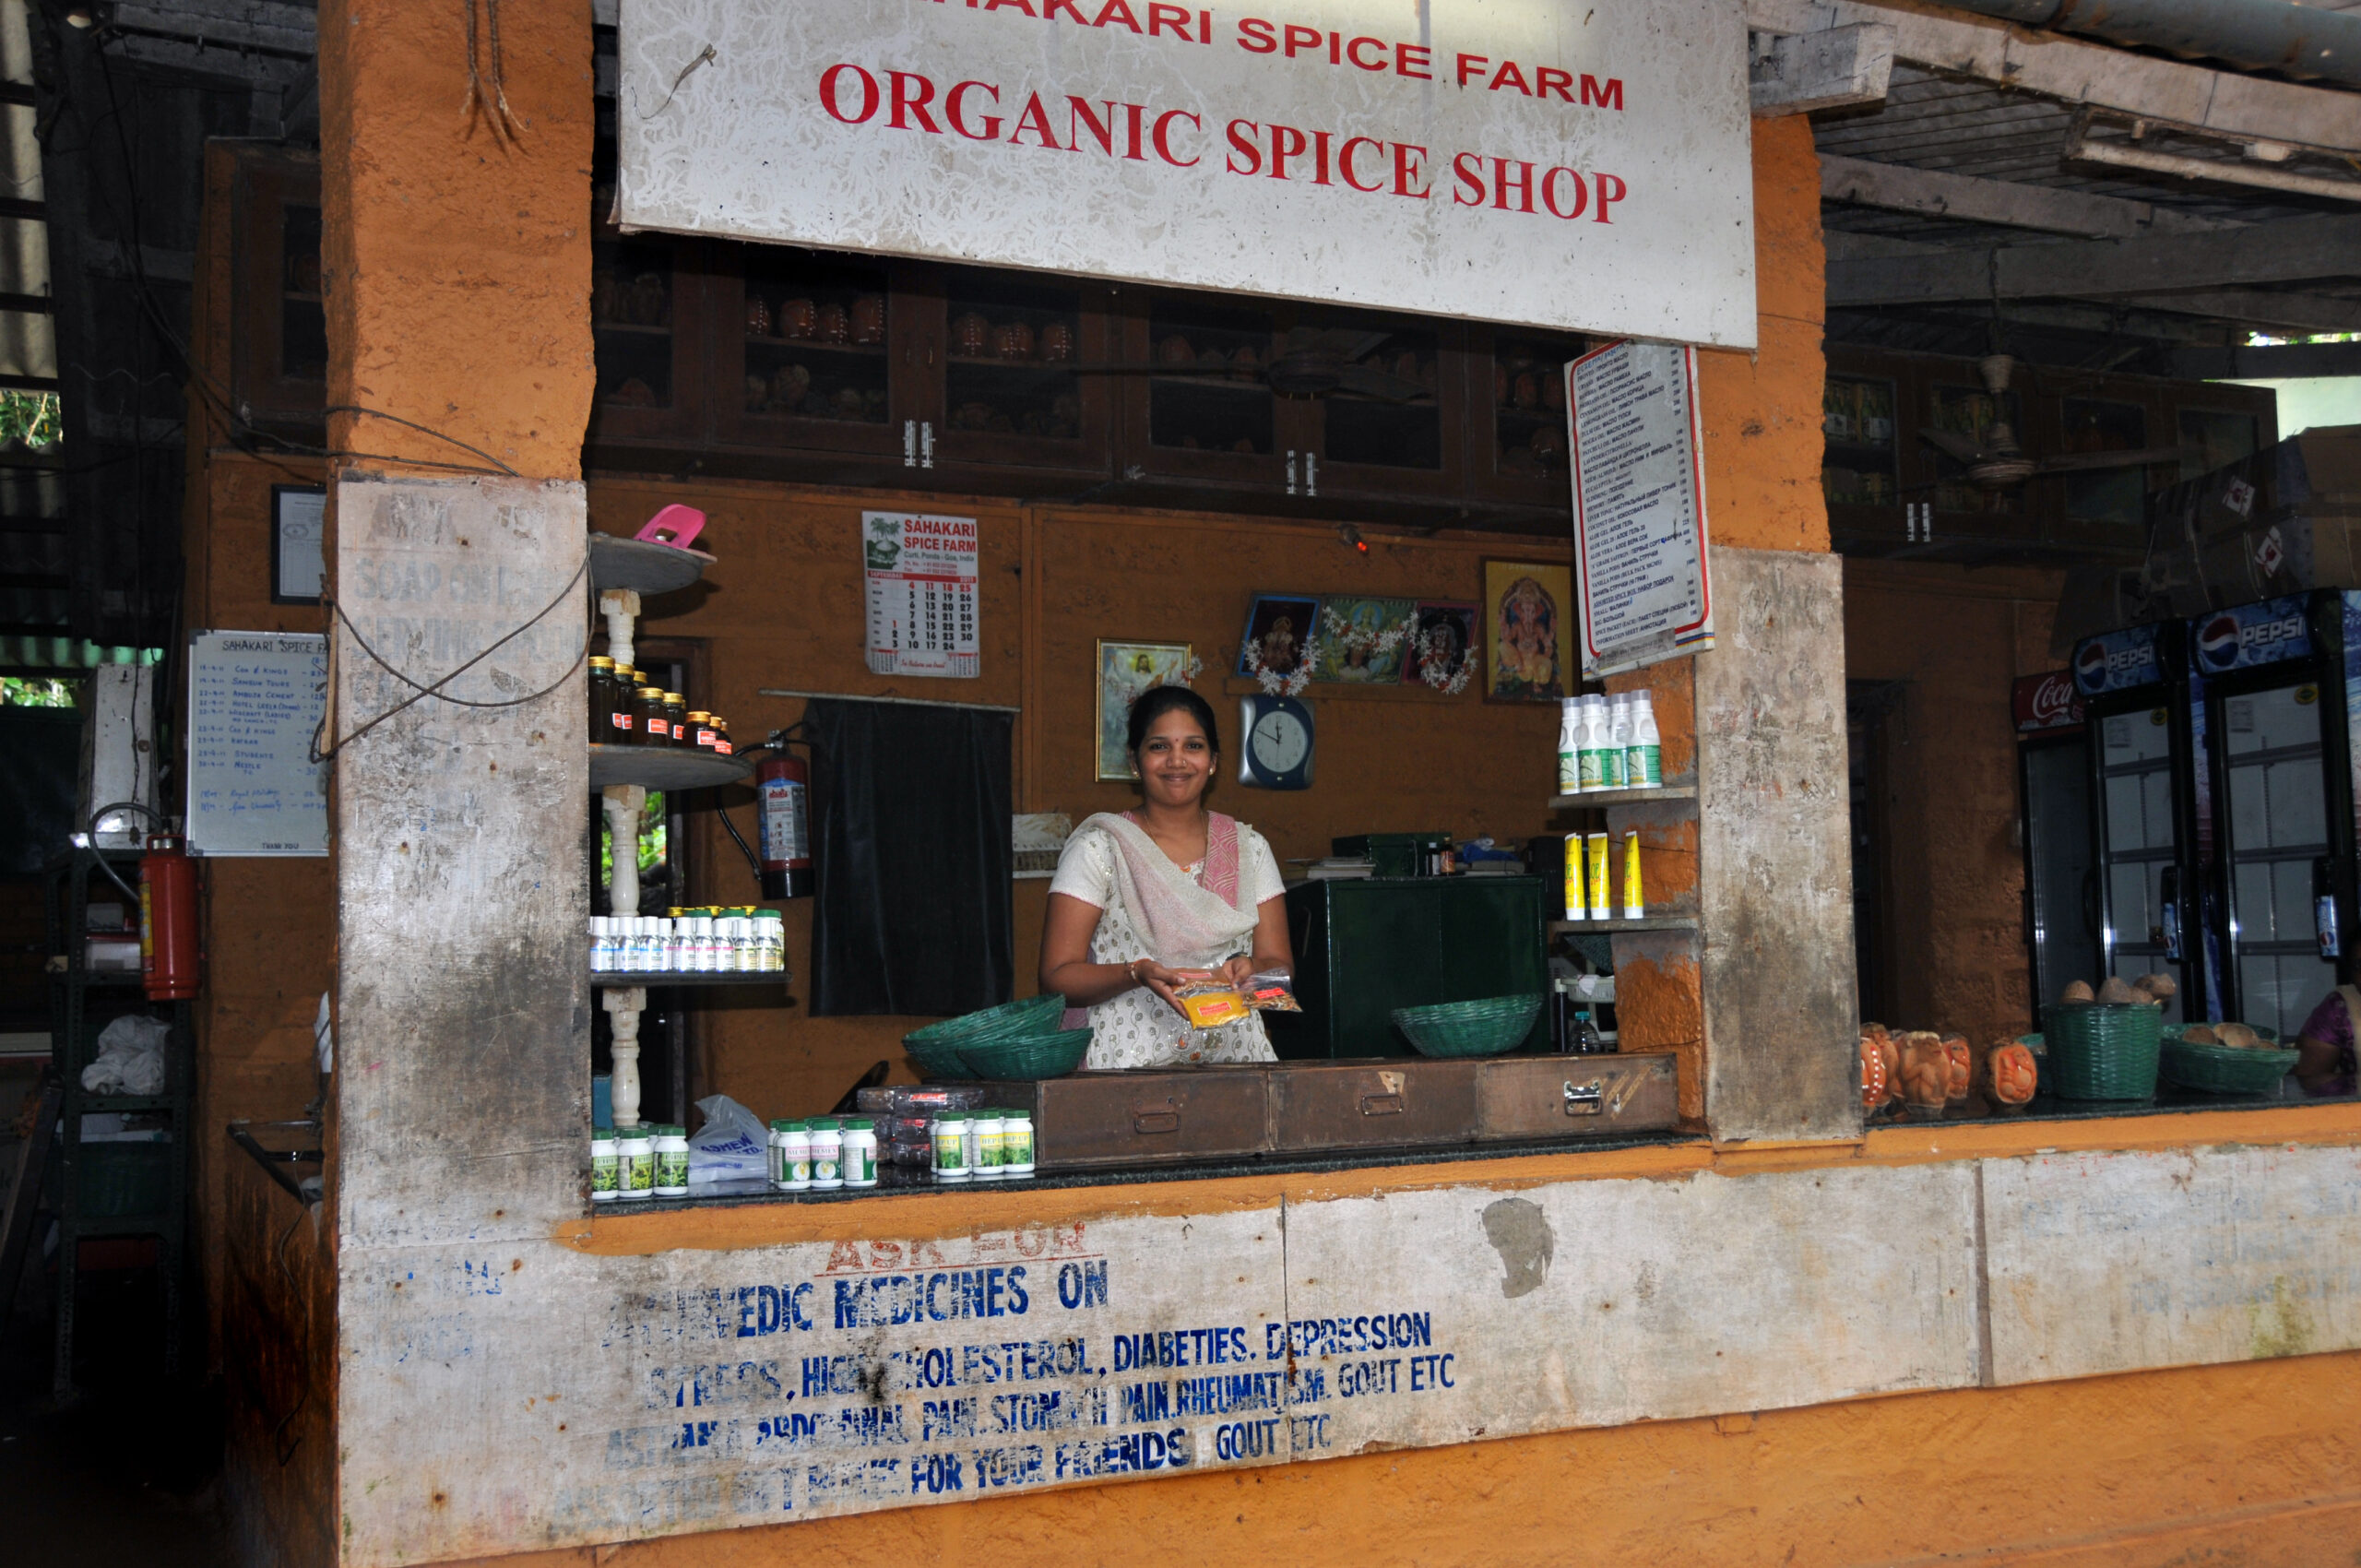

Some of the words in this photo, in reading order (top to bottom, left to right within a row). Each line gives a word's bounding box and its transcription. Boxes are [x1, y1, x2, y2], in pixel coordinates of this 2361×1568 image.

[932, 0, 1211, 44] AKARI
[1236, 18, 1432, 80] SPICE
[1456, 53, 1623, 111] FARM
[819, 64, 1201, 167] ORGANIC
[1226, 119, 1430, 199] SPICE
[1453, 151, 1627, 224] SHOP
[904, 518, 976, 537] SAHAKARI
[904, 536, 940, 551] SPICE
[943, 539, 977, 552] FARM
[926, 582, 933, 590] 11
[943, 583, 953, 591] 18
[959, 584, 971, 592] 25
[926, 591, 936, 600] 12
[943, 593, 953, 601] 19
[959, 594, 972, 602] 26
[926, 602, 936, 611] 13
[960, 603, 971, 612] 27
[926, 612, 936, 620] 14
[943, 612, 953, 621] 21
[960, 613, 972, 622] 28
[926, 622, 936, 630] 15
[943, 623, 954, 631] 22
[960, 623, 972, 631] 29
[926, 632, 936, 640] 16
[961, 633, 972, 641] 30
[2241, 615, 2305, 648] PEPSI
[221, 640, 274, 652] SAHAKARI
[908, 641, 919, 649] 10
[926, 641, 936, 649] 17
[943, 642, 955, 650] 24
[2108, 645, 2153, 671] PEPSI
[2032, 675, 2073, 719] Coca
[834, 1265, 1029, 1329] MEDICINES
[1058, 1259, 1108, 1310] ON
[1265, 1311, 1431, 1361] DEPRESSION
[1338, 1358, 1401, 1398] GOUT
[1410, 1352, 1455, 1392] ETC
[911, 1452, 964, 1495] FOR
[971, 1444, 1047, 1489] YOUR
[1054, 1427, 1191, 1481] FRIENDS
[1215, 1418, 1281, 1462] GOUT
[1291, 1413, 1332, 1452] ETC
